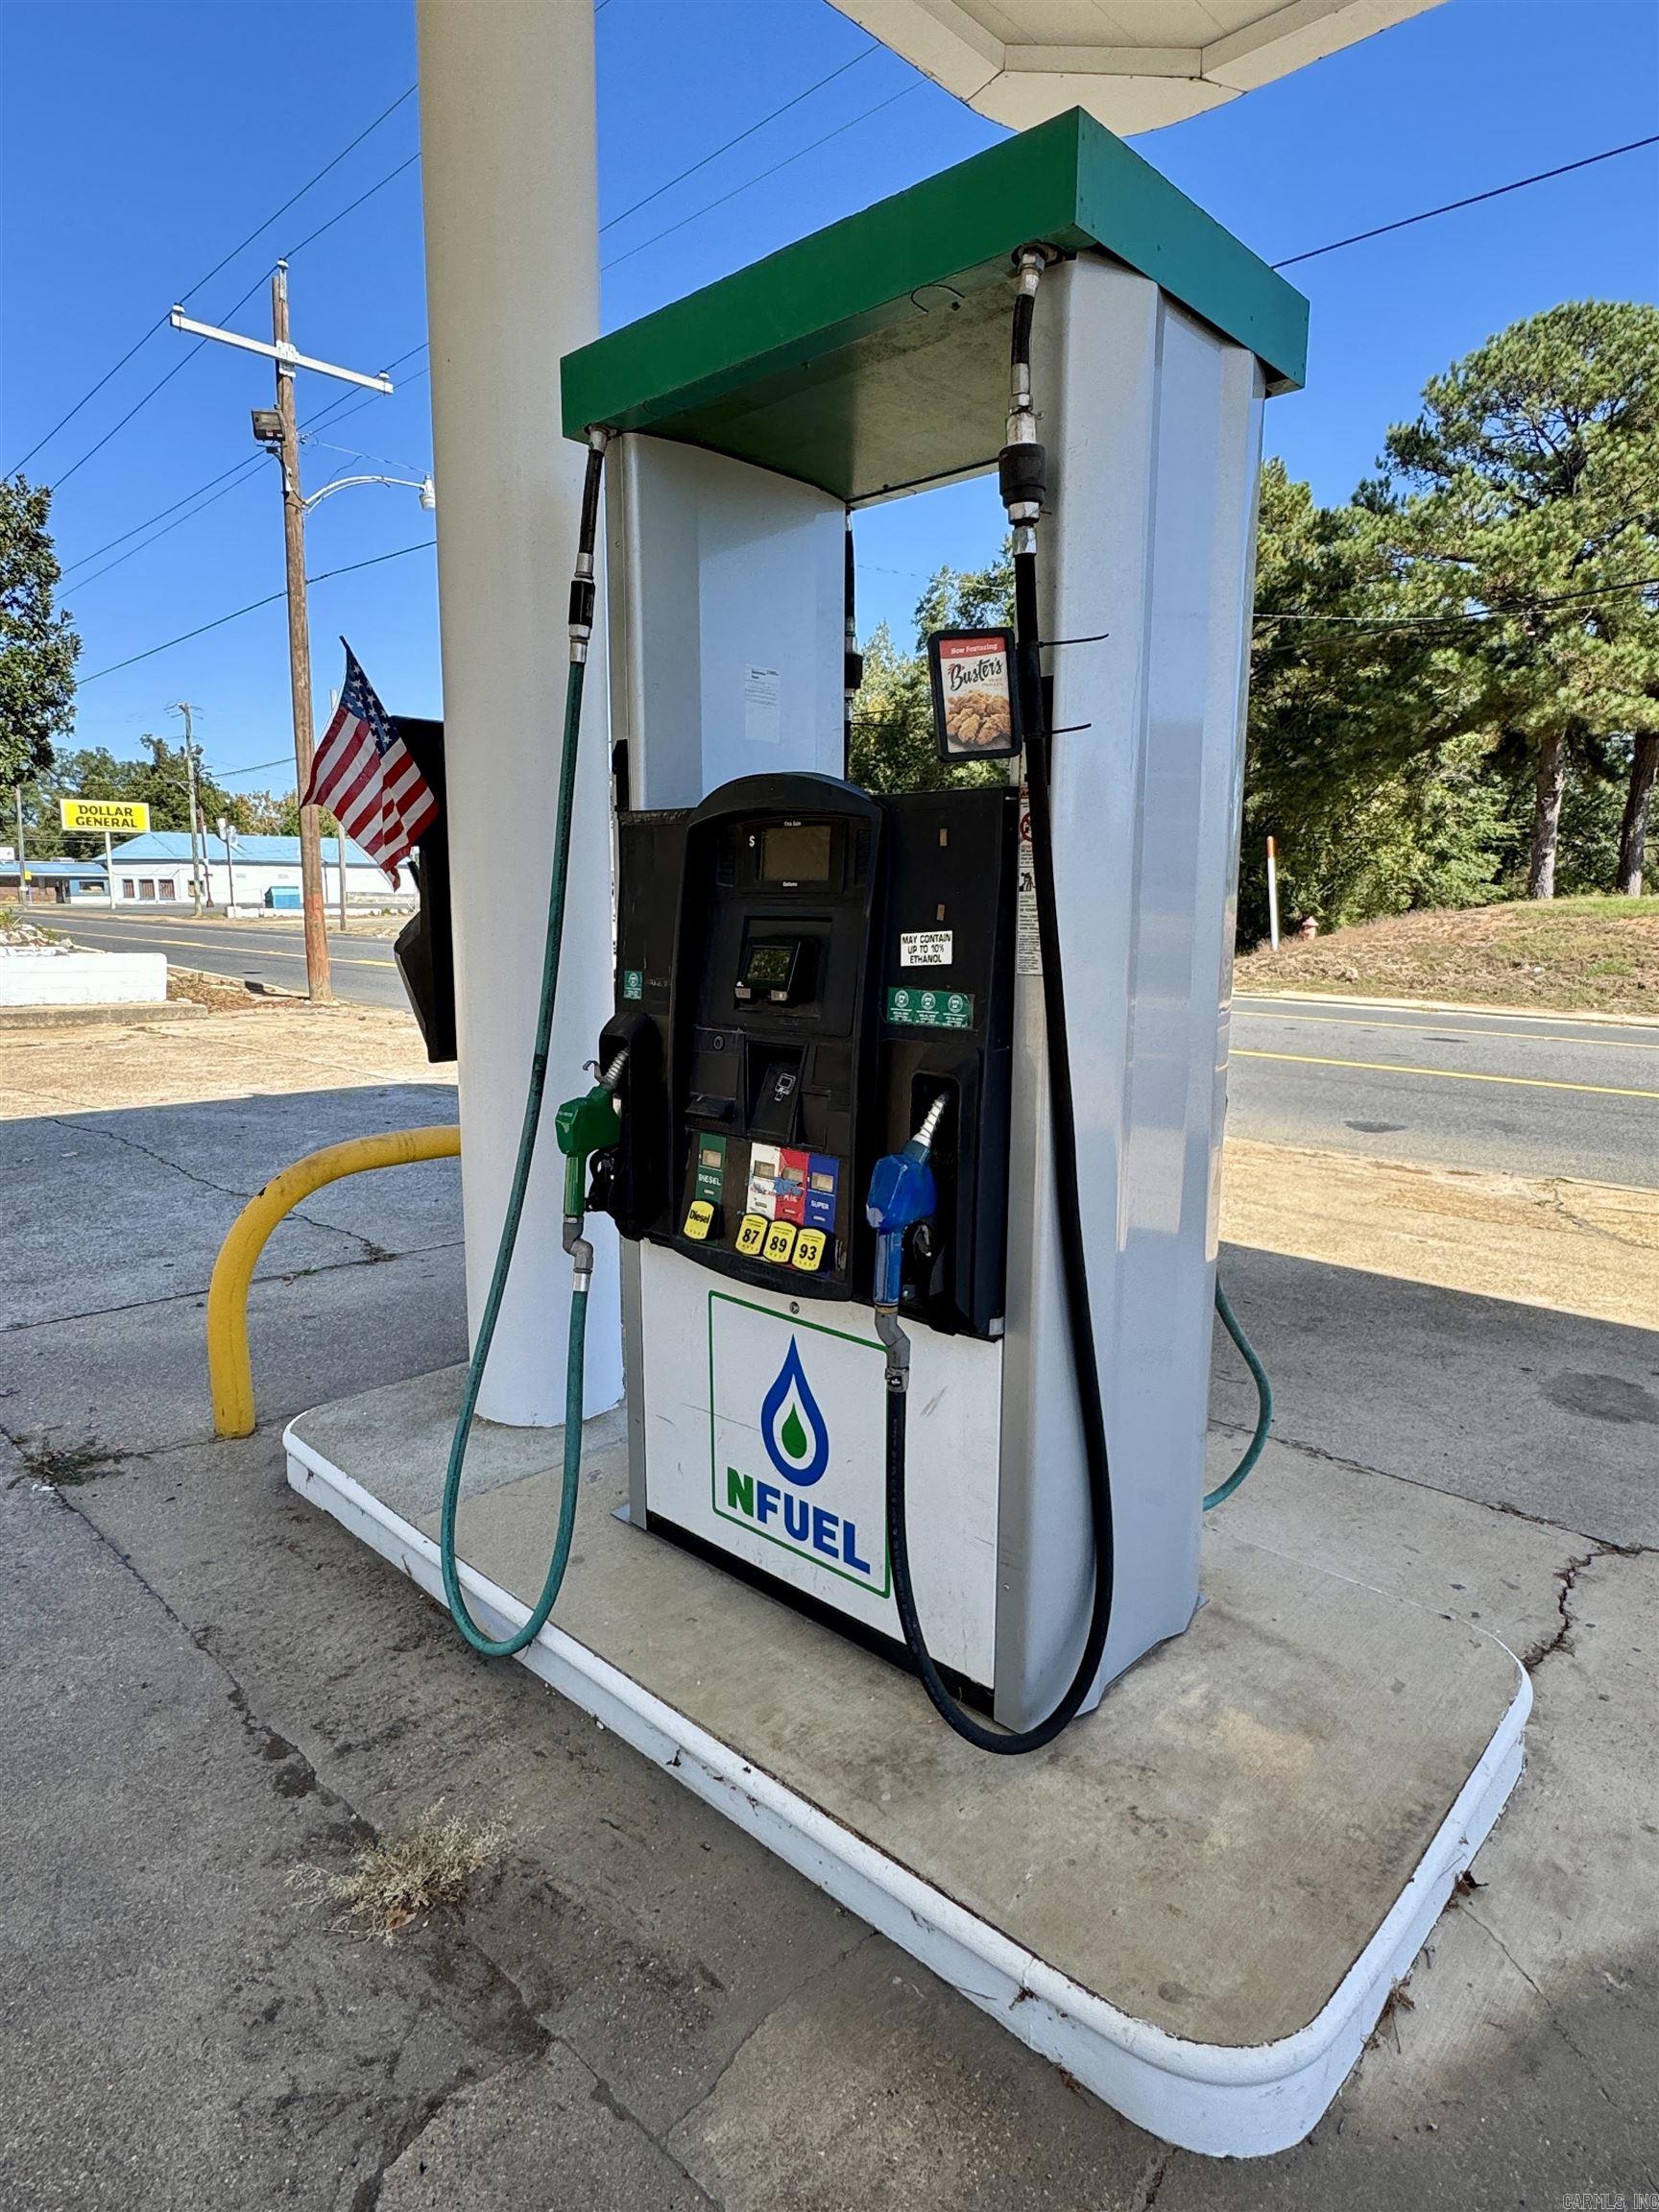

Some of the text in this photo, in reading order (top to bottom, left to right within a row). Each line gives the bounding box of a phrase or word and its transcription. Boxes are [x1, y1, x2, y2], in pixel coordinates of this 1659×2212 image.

[950, 658, 1003, 691] Buster's
[78, 805, 133, 817] DOLLAR
[76, 816, 138, 828] GENERAL
[902, 932, 950, 944] MAY CONTAIN
[907, 944, 945, 954] UP TO 10%
[909, 954, 943, 964] ETHANOL
[698, 1173, 722, 1186] DIESEL
[810, 1199, 830, 1210] SUPER
[689, 1210, 710, 1224] Diesel
[742, 1228, 760, 1244] 87
[769, 1236, 787, 1253] 89
[799, 1243, 817, 1261] 93
[727, 1466, 871, 1575] NFUEL
